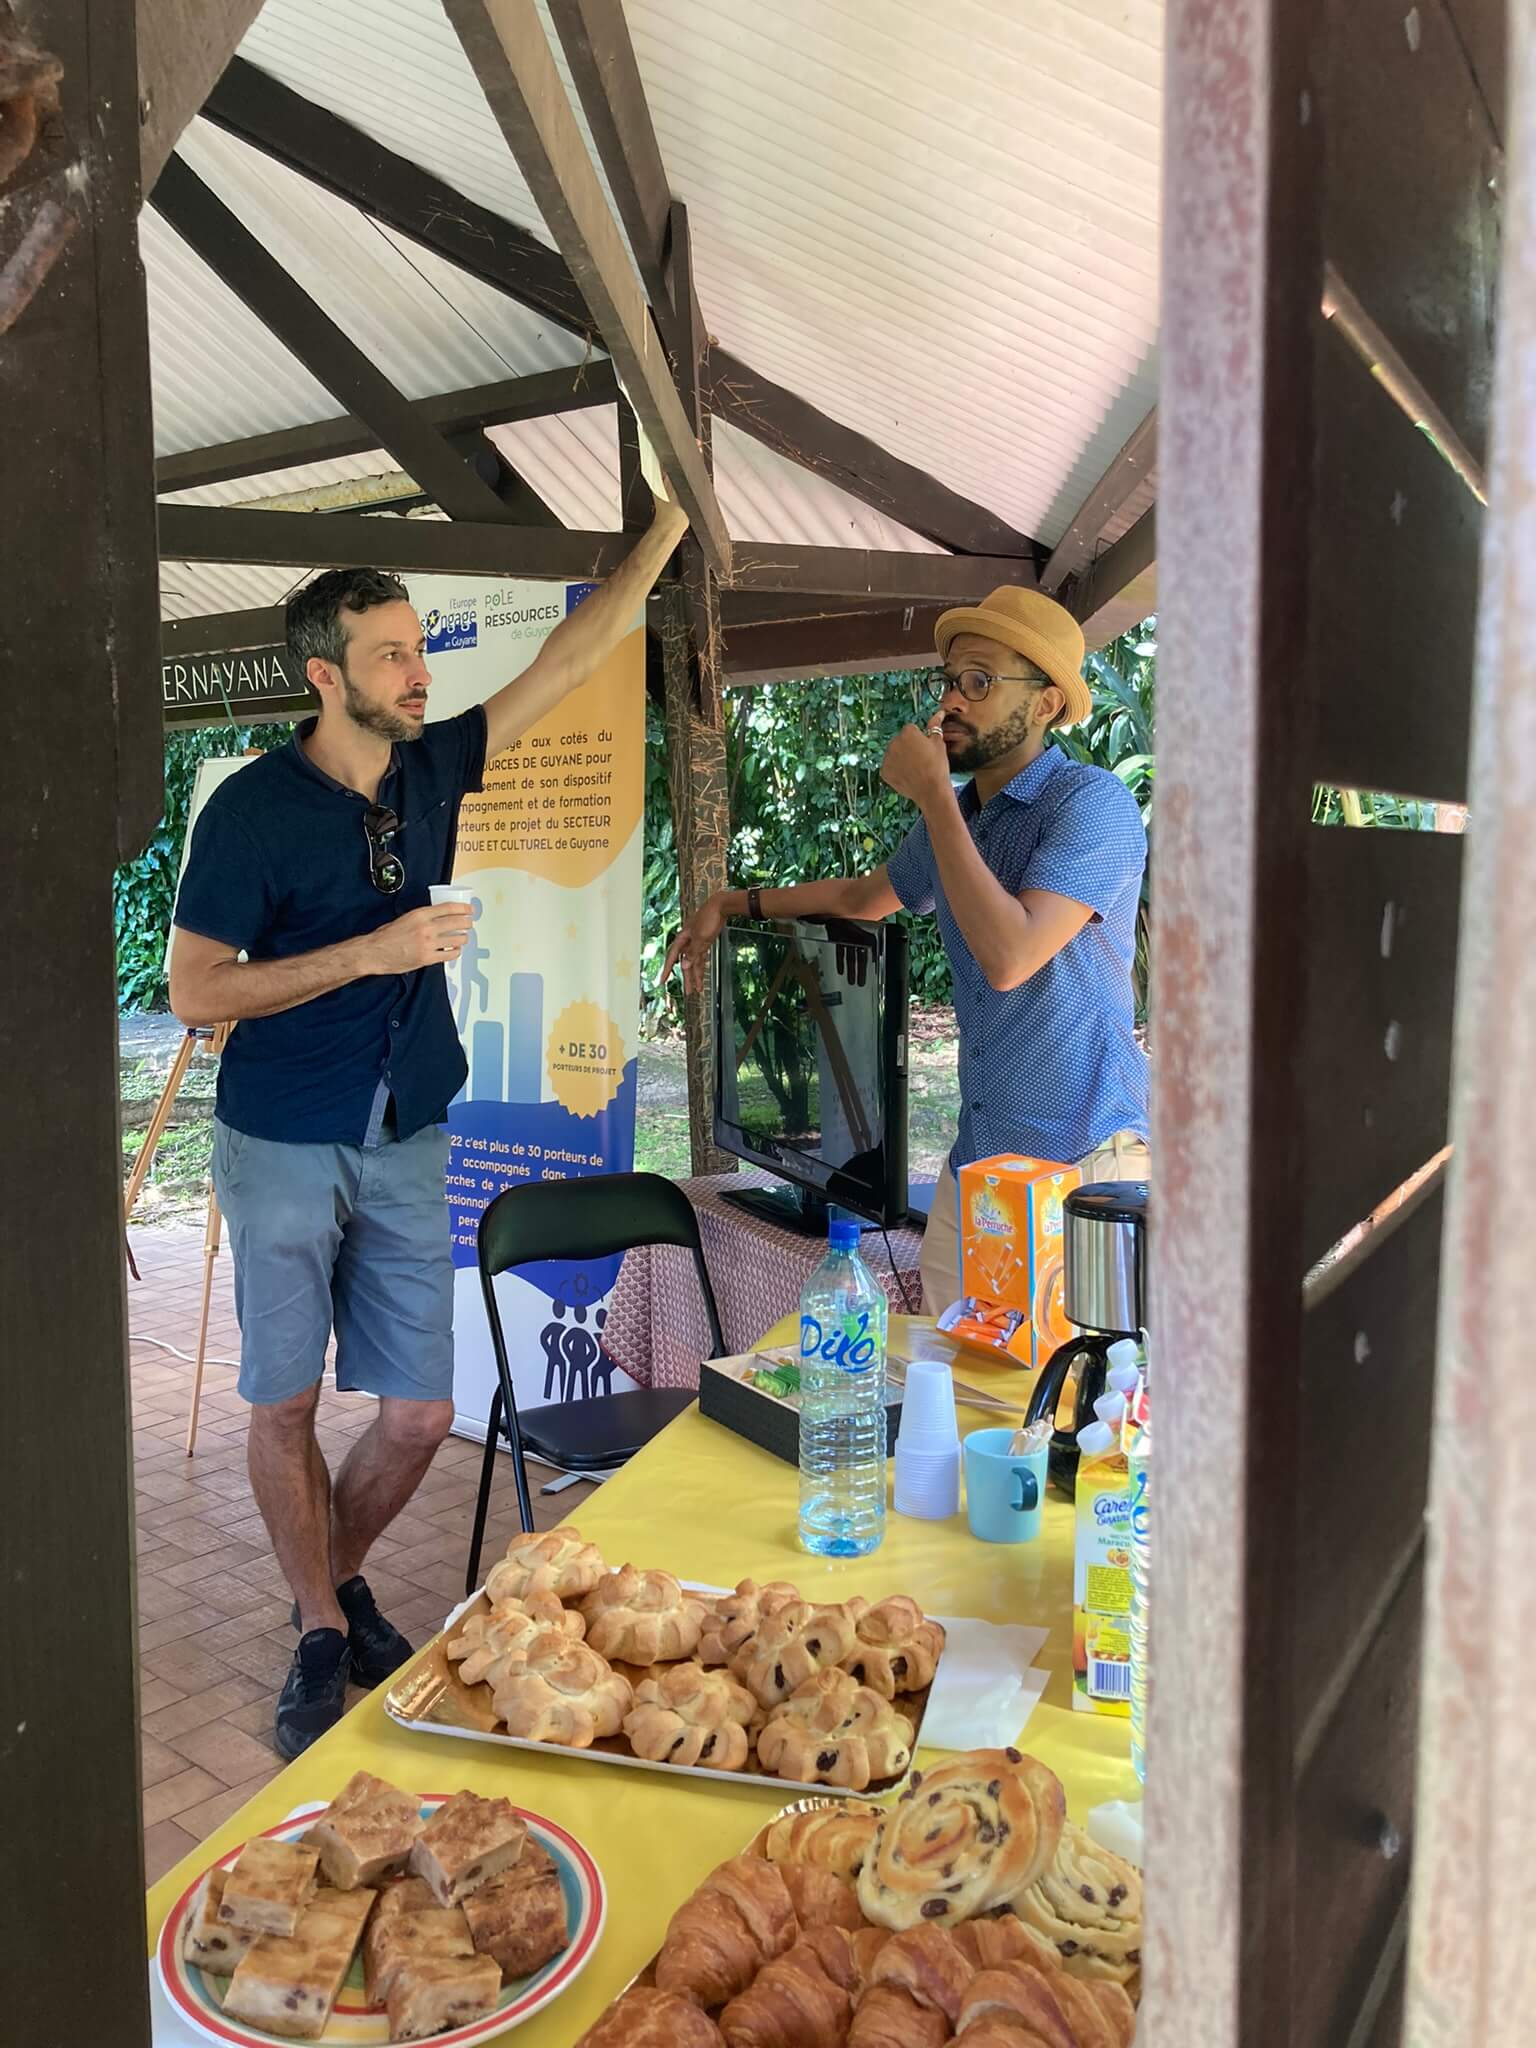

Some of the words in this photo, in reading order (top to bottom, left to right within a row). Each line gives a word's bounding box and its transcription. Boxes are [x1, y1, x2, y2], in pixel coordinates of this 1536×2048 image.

[485, 605, 559, 628] RESSOURCES
[531, 737, 551, 748] aux
[597, 729, 612, 742] du
[522, 756, 537, 769] DE
[540, 753, 582, 767] GUYANE
[586, 753, 612, 766] pour
[521, 777, 534, 789] de
[540, 778, 558, 788] son
[563, 771, 612, 788] dispositif
[528, 797, 538, 809] et
[542, 796, 555, 809] de
[560, 793, 611, 808] formation
[494, 819, 506, 831] de
[510, 818, 541, 832] projet
[546, 817, 559, 829] du
[563, 815, 611, 828] SECTEUR
[487, 839, 498, 851] ET
[500, 838, 553, 851] CULTUREL
[555, 837, 568, 849] de
[569, 838, 609, 851] Guyane
[569, 1042, 586, 1058] DE
[589, 1044, 607, 1060] 30
[553, 1063, 583, 1073] PORTEURS
[465, 1137, 488, 1150] c'est
[489, 1140, 510, 1153] plus
[511, 1143, 525, 1155] de
[527, 1144, 542, 1158] 30
[544, 1148, 588, 1165] porteurs
[589, 1153, 604, 1167] de
[462, 1158, 531, 1177] accompagnés
[481, 1178, 494, 1191] de
